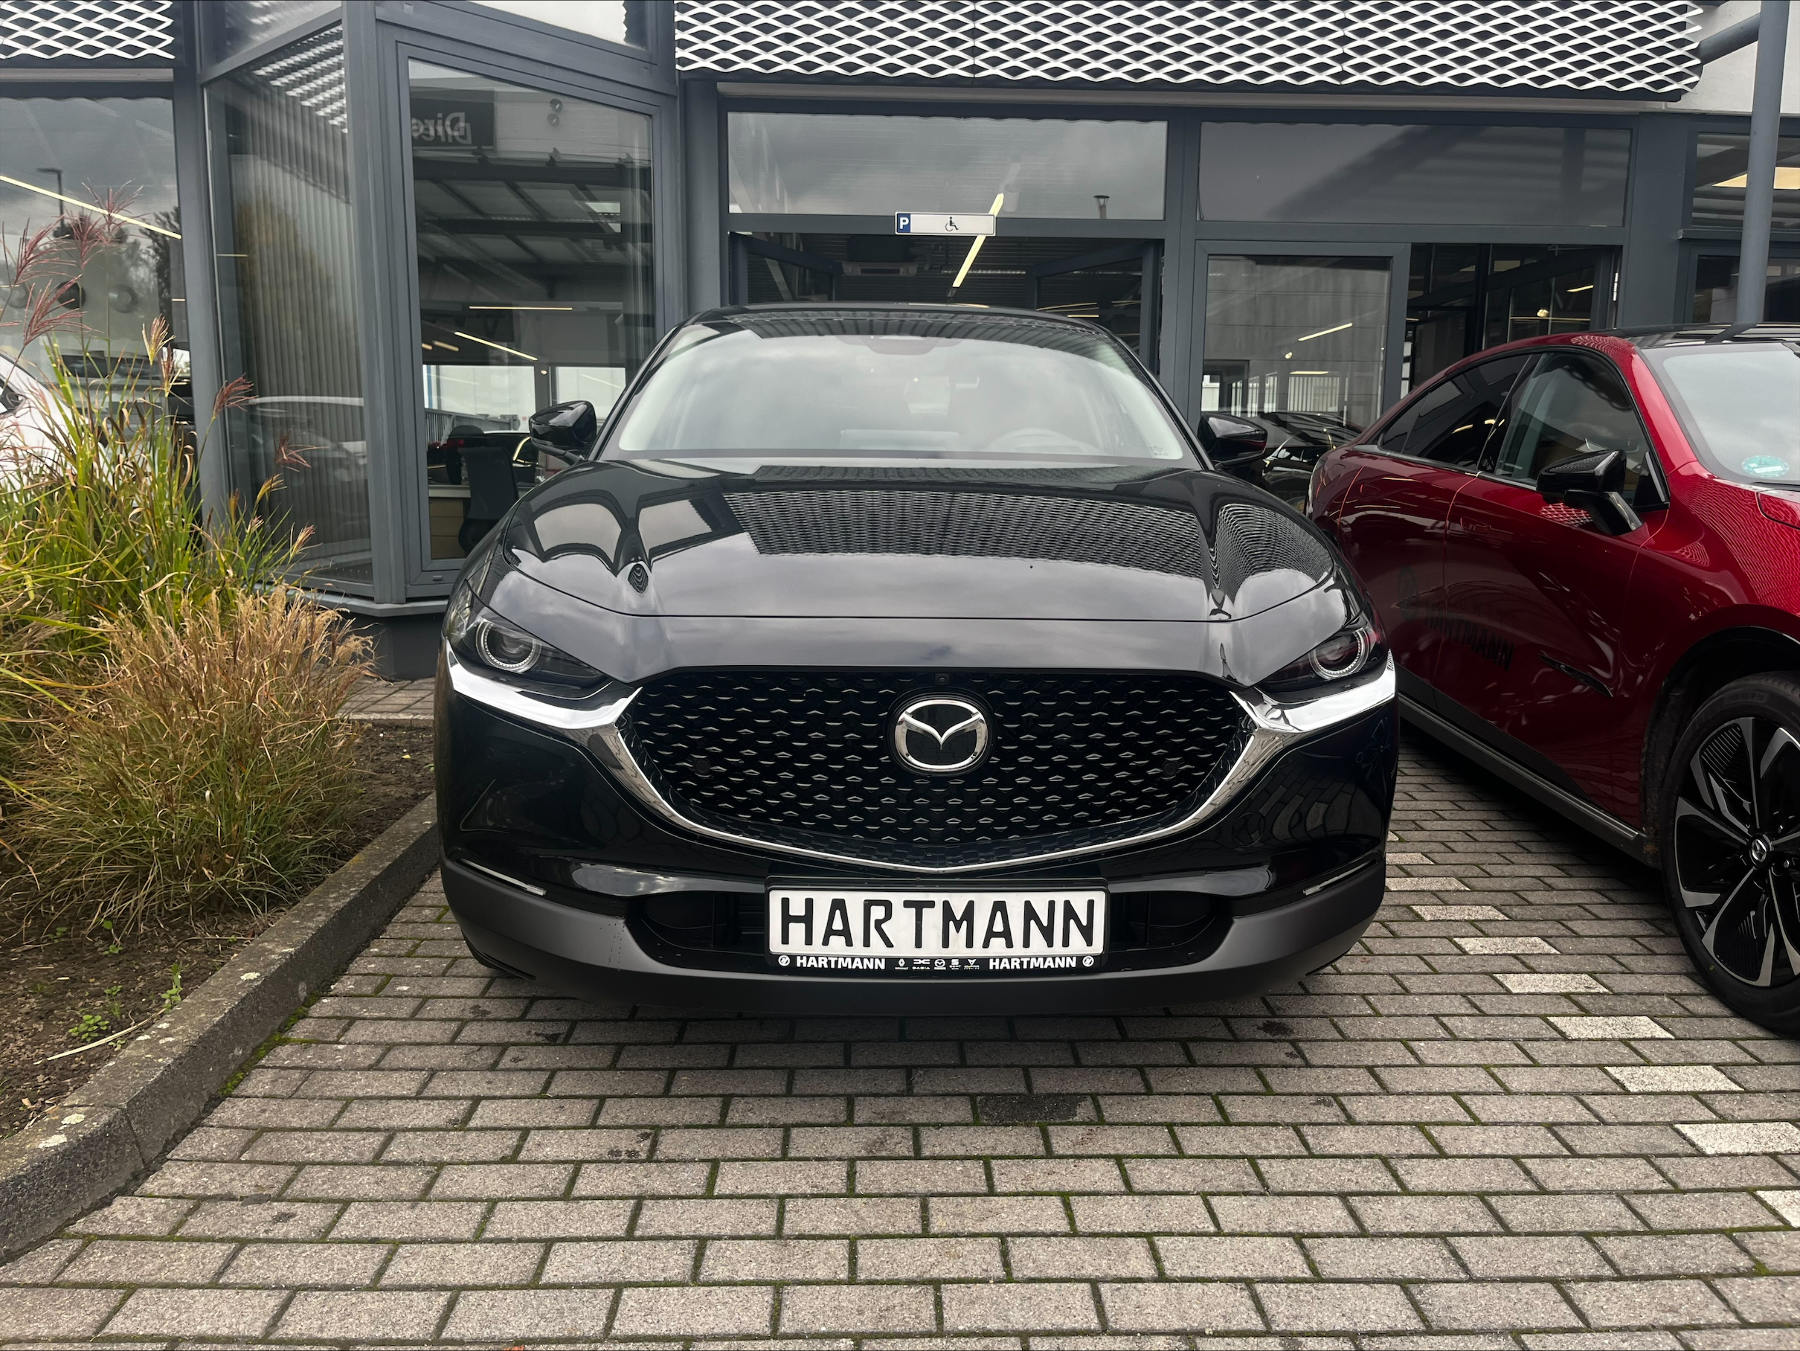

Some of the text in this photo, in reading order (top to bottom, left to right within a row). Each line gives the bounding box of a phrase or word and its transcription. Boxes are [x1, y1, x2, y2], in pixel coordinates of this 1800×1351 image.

[899, 217, 910, 230] P
[781, 897, 1095, 949] HARTMANN
[796, 956, 886, 970] HARTMANN
[989, 957, 1077, 970] HARTMANN
